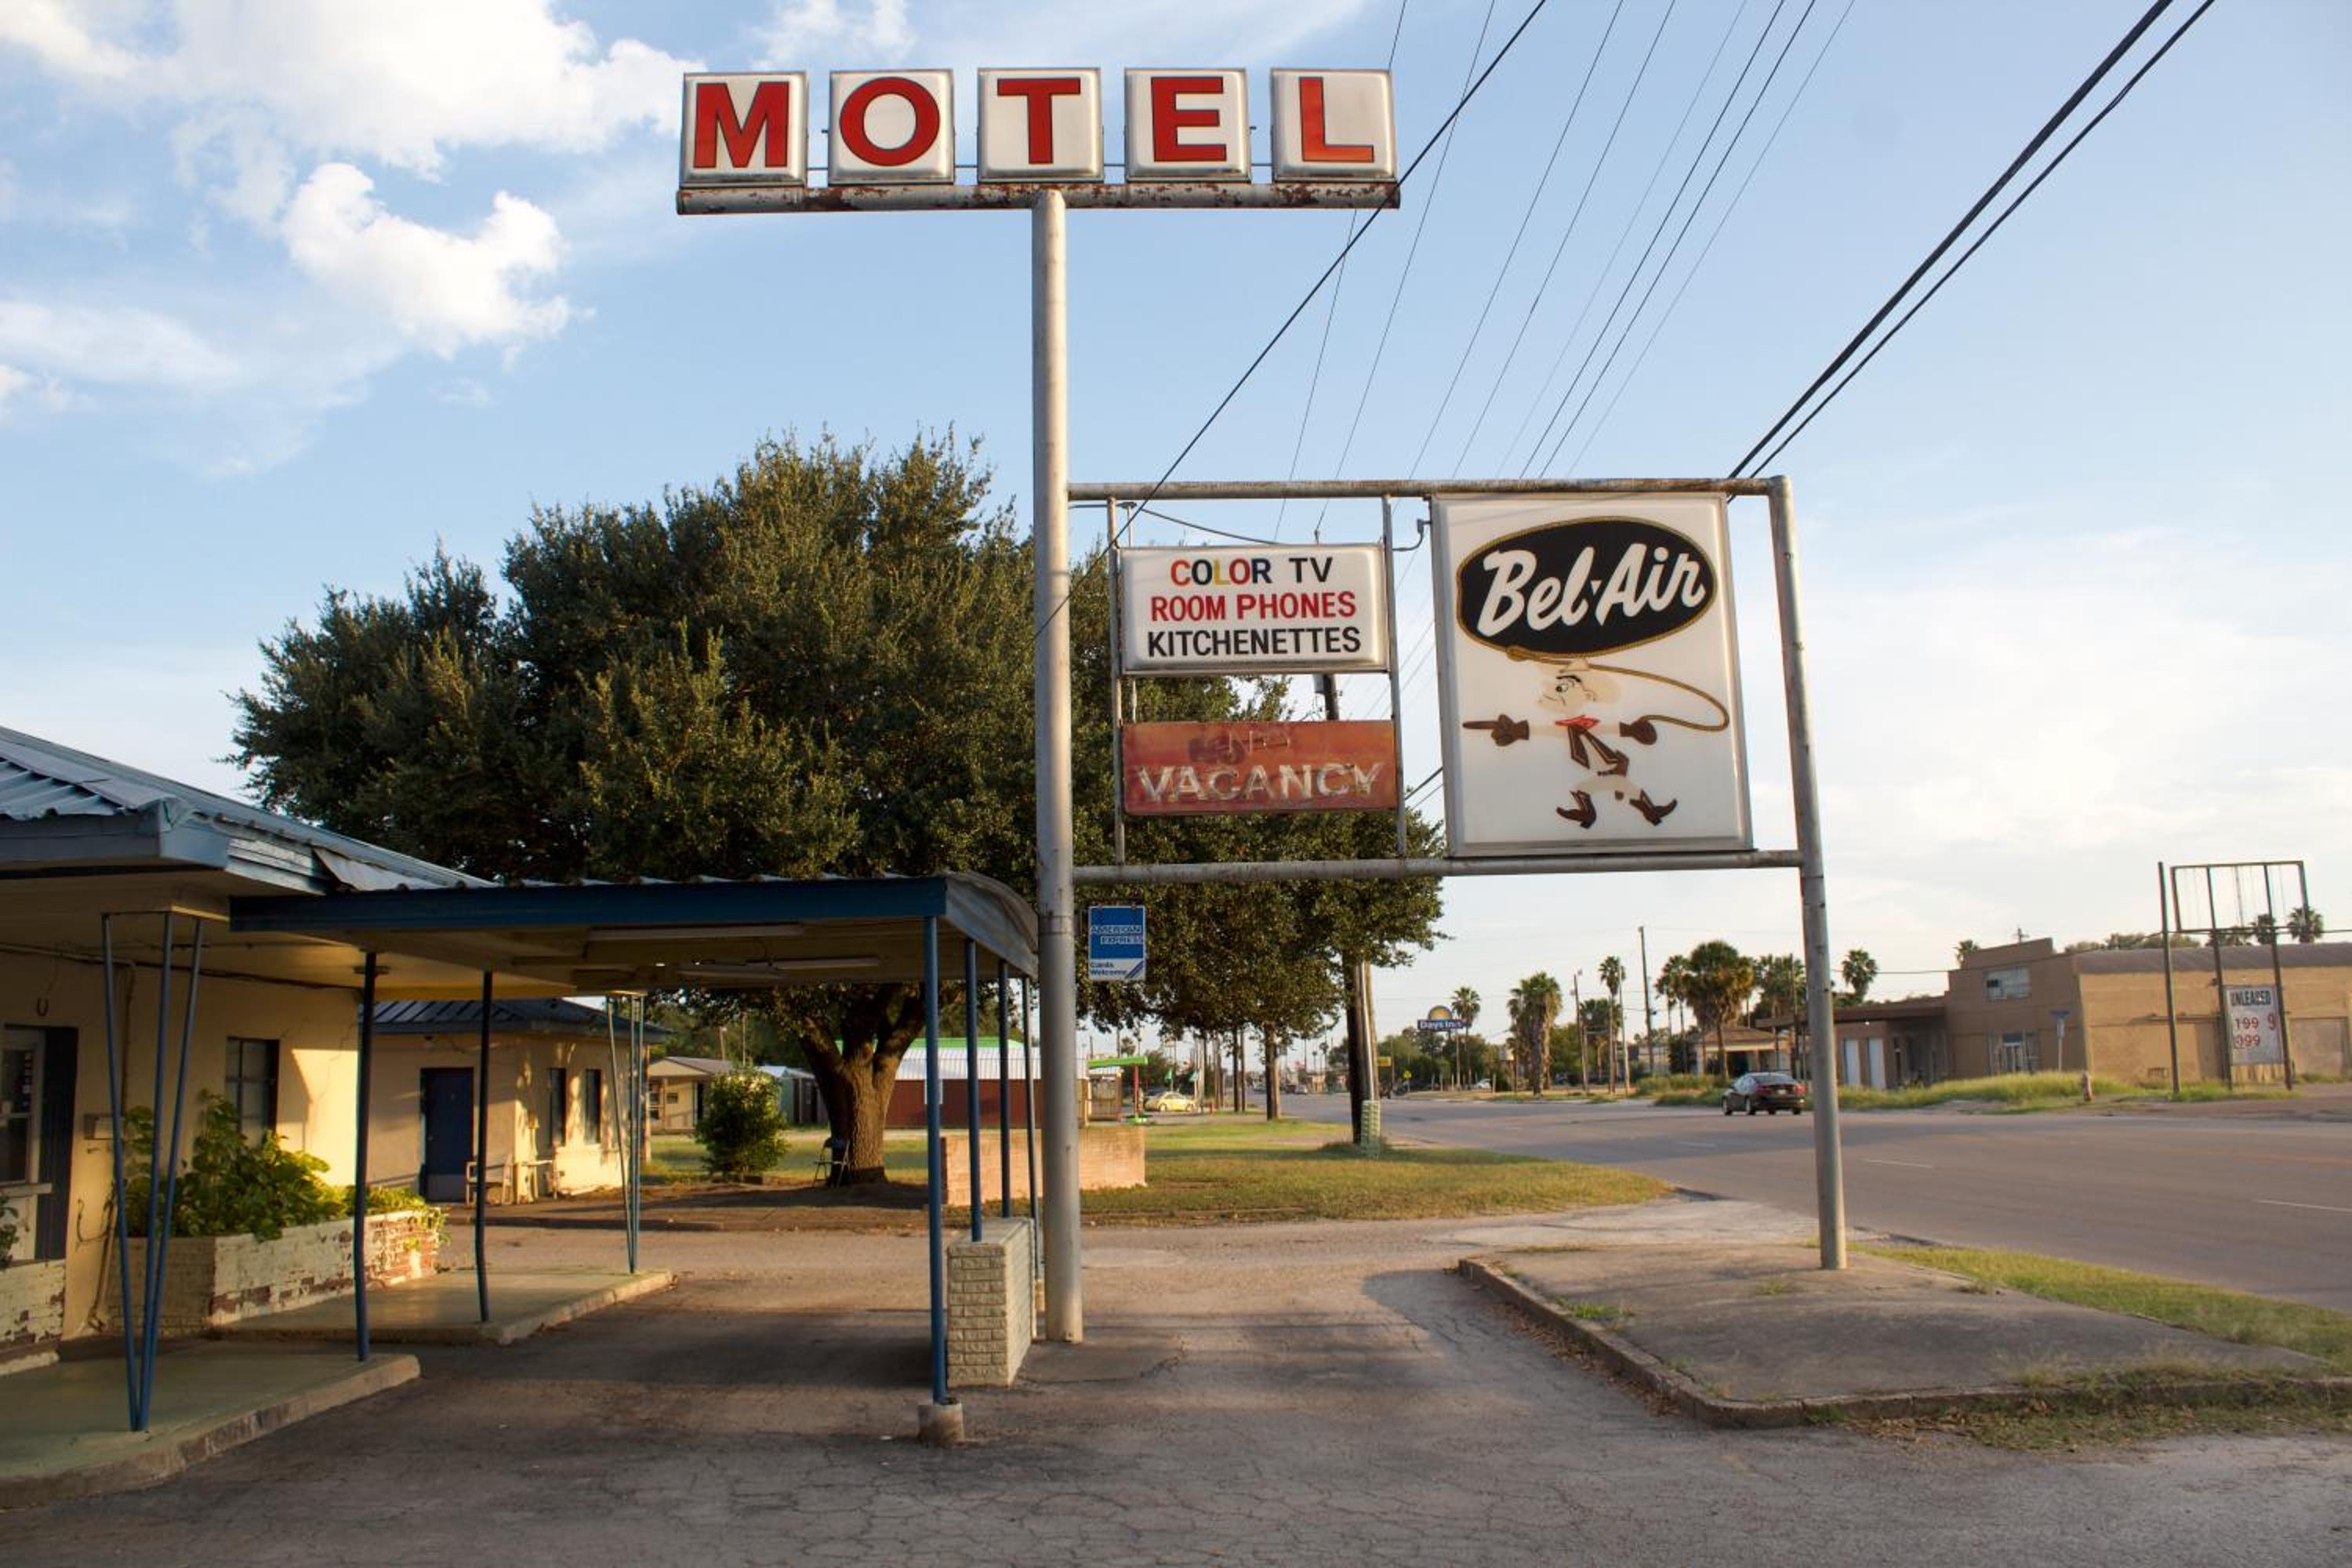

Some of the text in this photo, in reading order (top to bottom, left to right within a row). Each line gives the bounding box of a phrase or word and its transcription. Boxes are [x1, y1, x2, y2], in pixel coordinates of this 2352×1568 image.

[693, 76, 1375, 168] MOTEL
[1171, 557, 1333, 586] COLOR TV
[1150, 591, 1356, 622] ROOM PHONES
[1148, 626, 1361, 658] KITCHENETTES
[1138, 762, 1385, 803] VACANCY
[1091, 924, 1143, 935] AMERICAN
[1100, 935, 1144, 946] EXPRESS
[1420, 1021, 1443, 1029] Days
